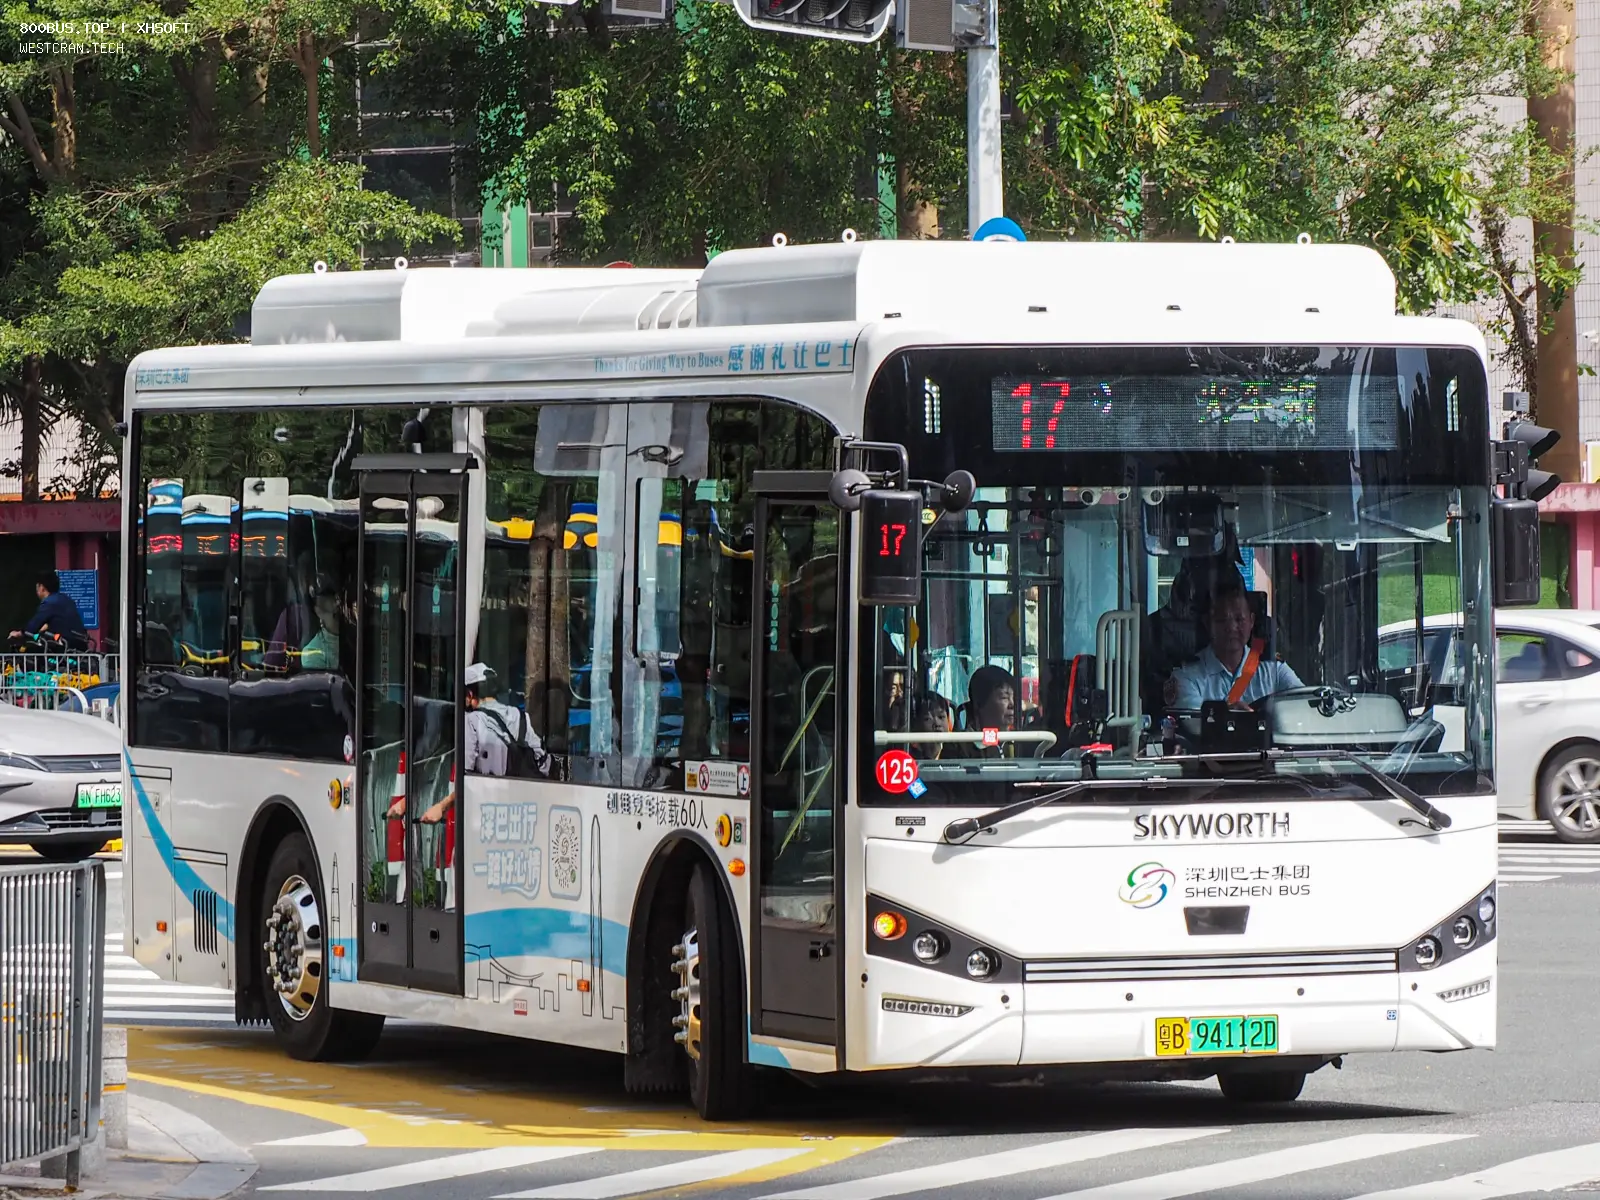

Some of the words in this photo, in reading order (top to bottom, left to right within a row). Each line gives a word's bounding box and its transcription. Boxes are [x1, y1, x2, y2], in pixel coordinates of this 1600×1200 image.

[639, 355, 667, 373] Giving
[668, 354, 686, 371] Way
[687, 355, 696, 368] to
[698, 352, 724, 368] Buses
[727, 339, 854, 372] 感谢礼让巴士
[1011, 383, 1071, 449] 17
[880, 524, 907, 556] 17
[880, 759, 914, 785] 125
[480, 802, 537, 844] 深巴出行
[1134, 811, 1290, 840] SKYWORTH
[1186, 864, 1310, 882] 深圳巴士集团
[1185, 886, 1272, 898] SHENZHEN
[1279, 885, 1311, 896] BUS
[1159, 1023, 1185, 1050] 粤B
[1196, 1020, 1277, 1049] 94112D
